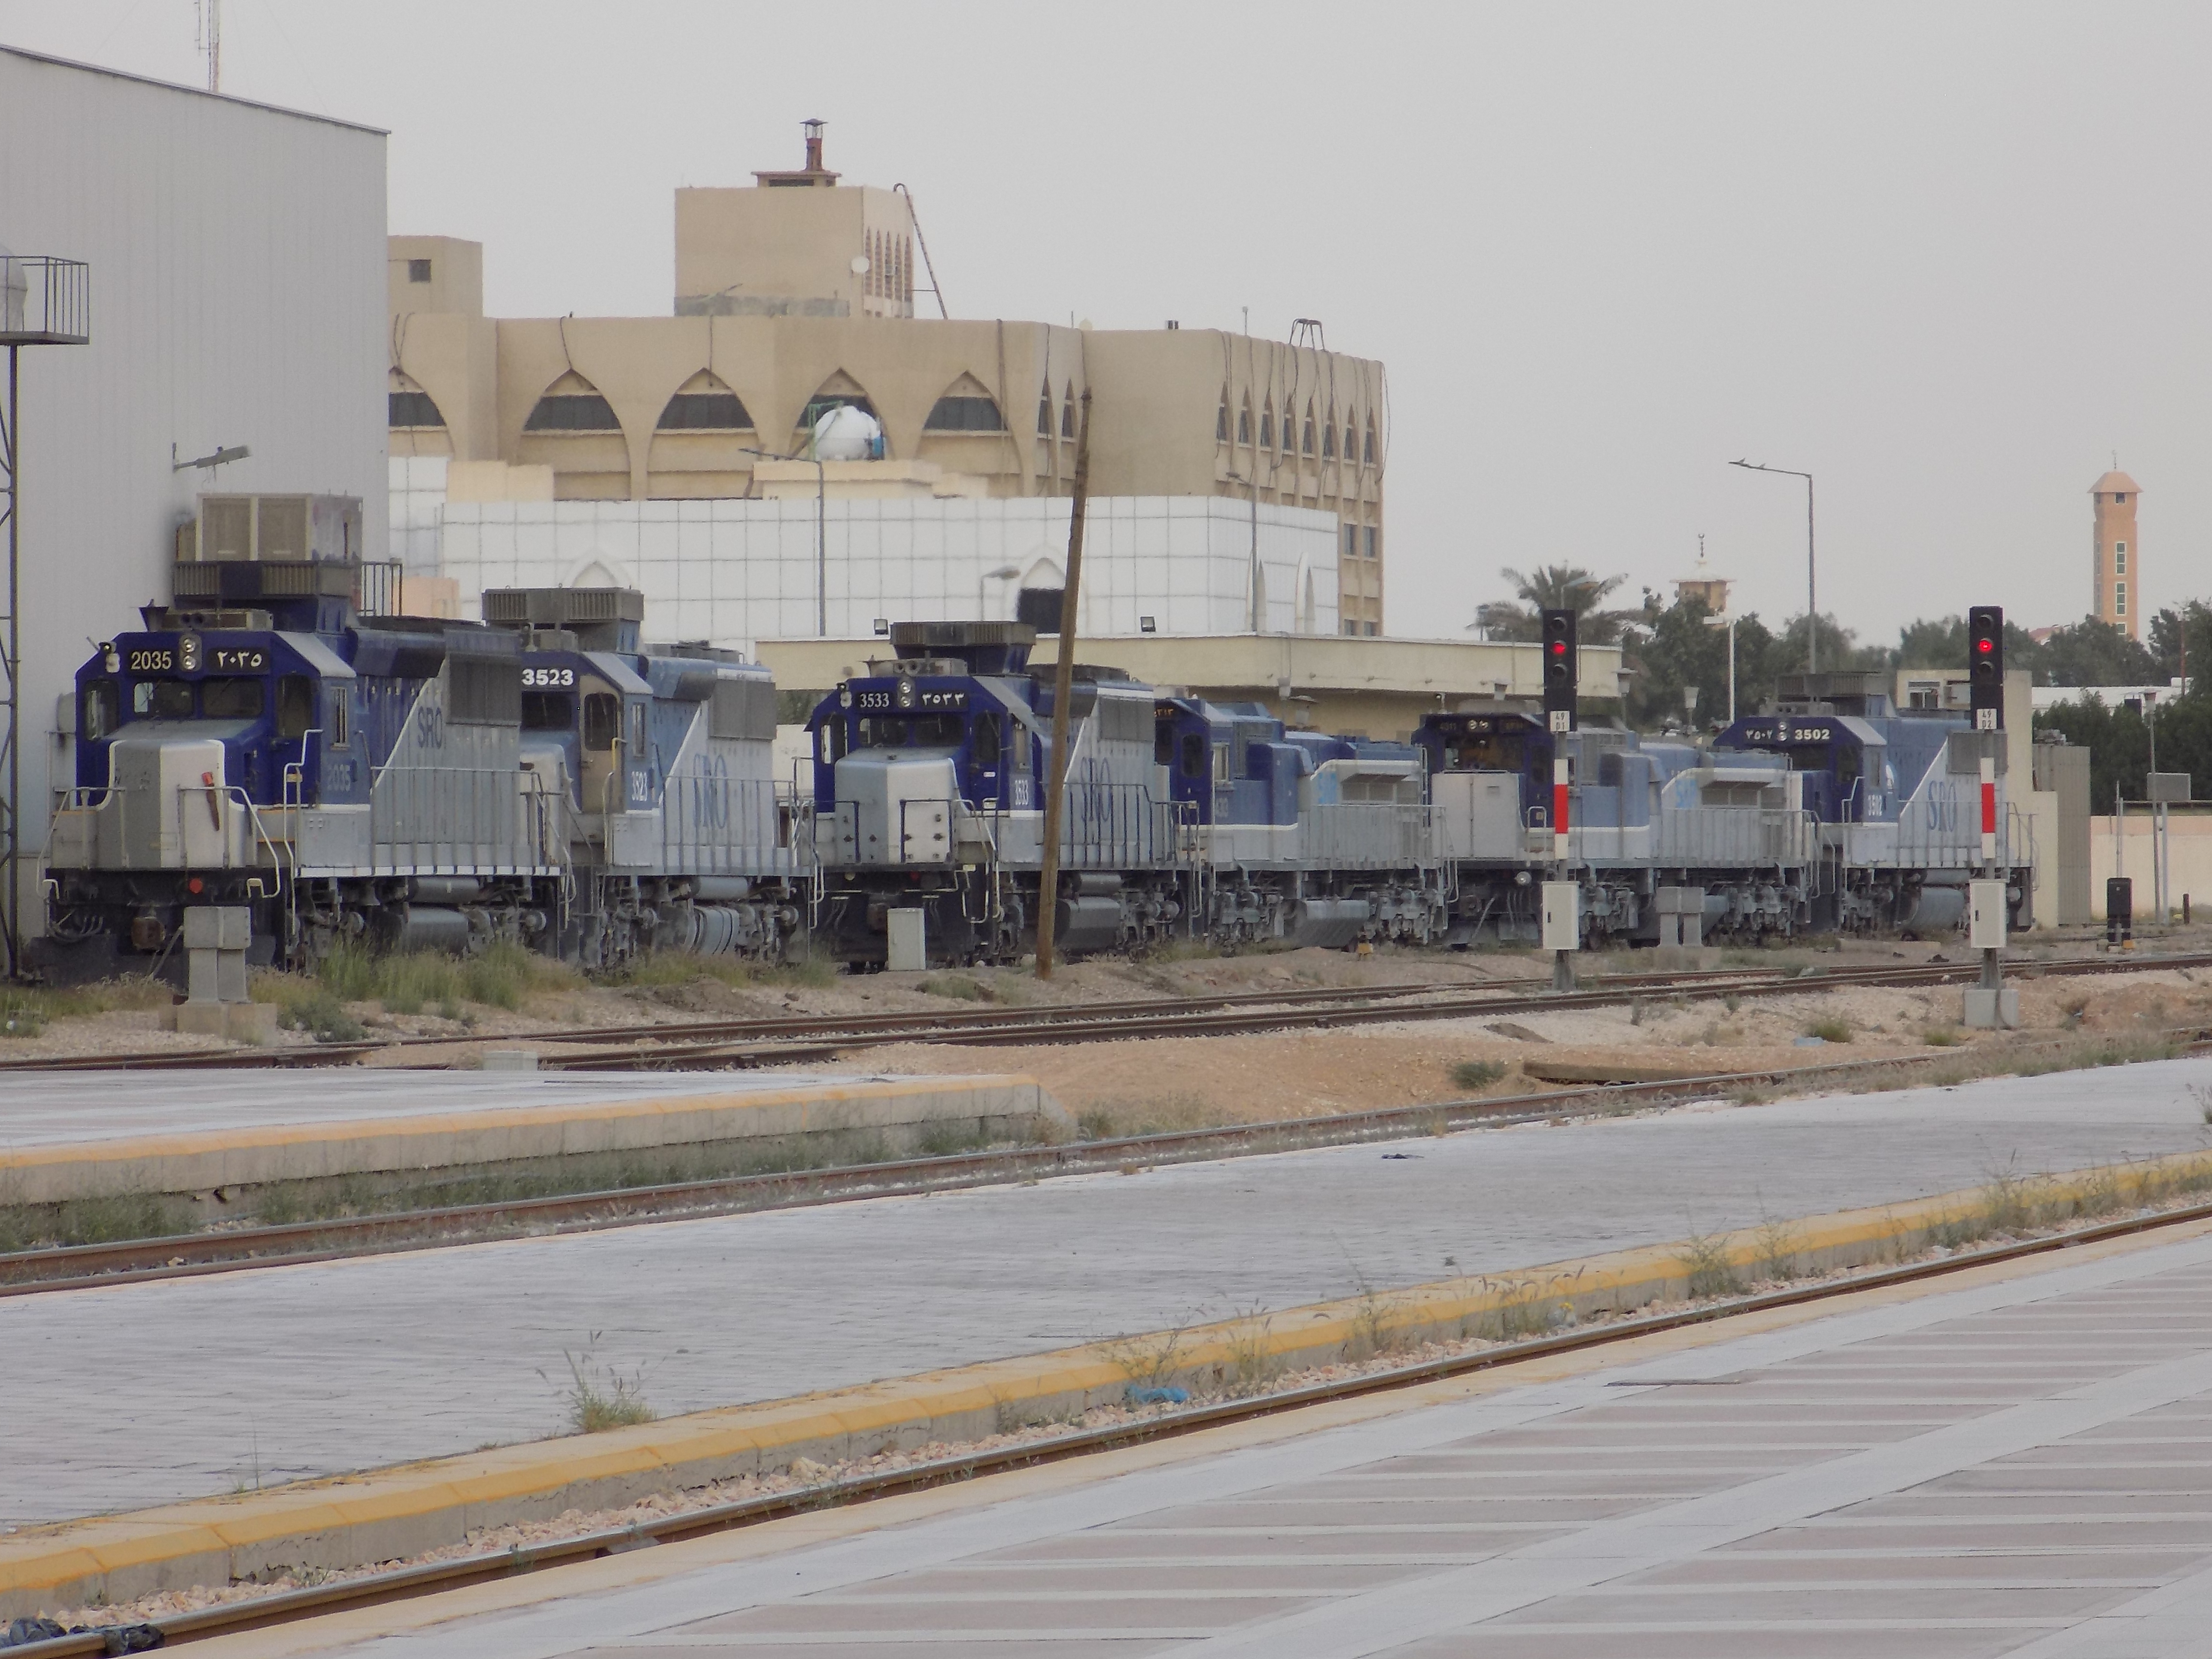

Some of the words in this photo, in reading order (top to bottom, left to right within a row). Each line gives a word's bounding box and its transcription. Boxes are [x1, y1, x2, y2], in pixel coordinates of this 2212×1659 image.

[130, 650, 172, 670] 2035
[217, 650, 262, 668] ٢٠٣٥
[521, 668, 574, 686] 3523
[860, 692, 890, 708] 3533
[922, 693, 965, 706] ٣٥٣٣
[1556, 712, 1565, 720] 49
[1982, 709, 1991, 718] 49
[417, 705, 443, 749] SRO
[1795, 729, 1830, 740] 3502
[631, 771, 647, 802] 3523
[693, 753, 728, 830] SRO
[1015, 780, 1029, 805] 3533
[1080, 757, 1112, 822] SRO
[1926, 780, 1958, 832] SRO
